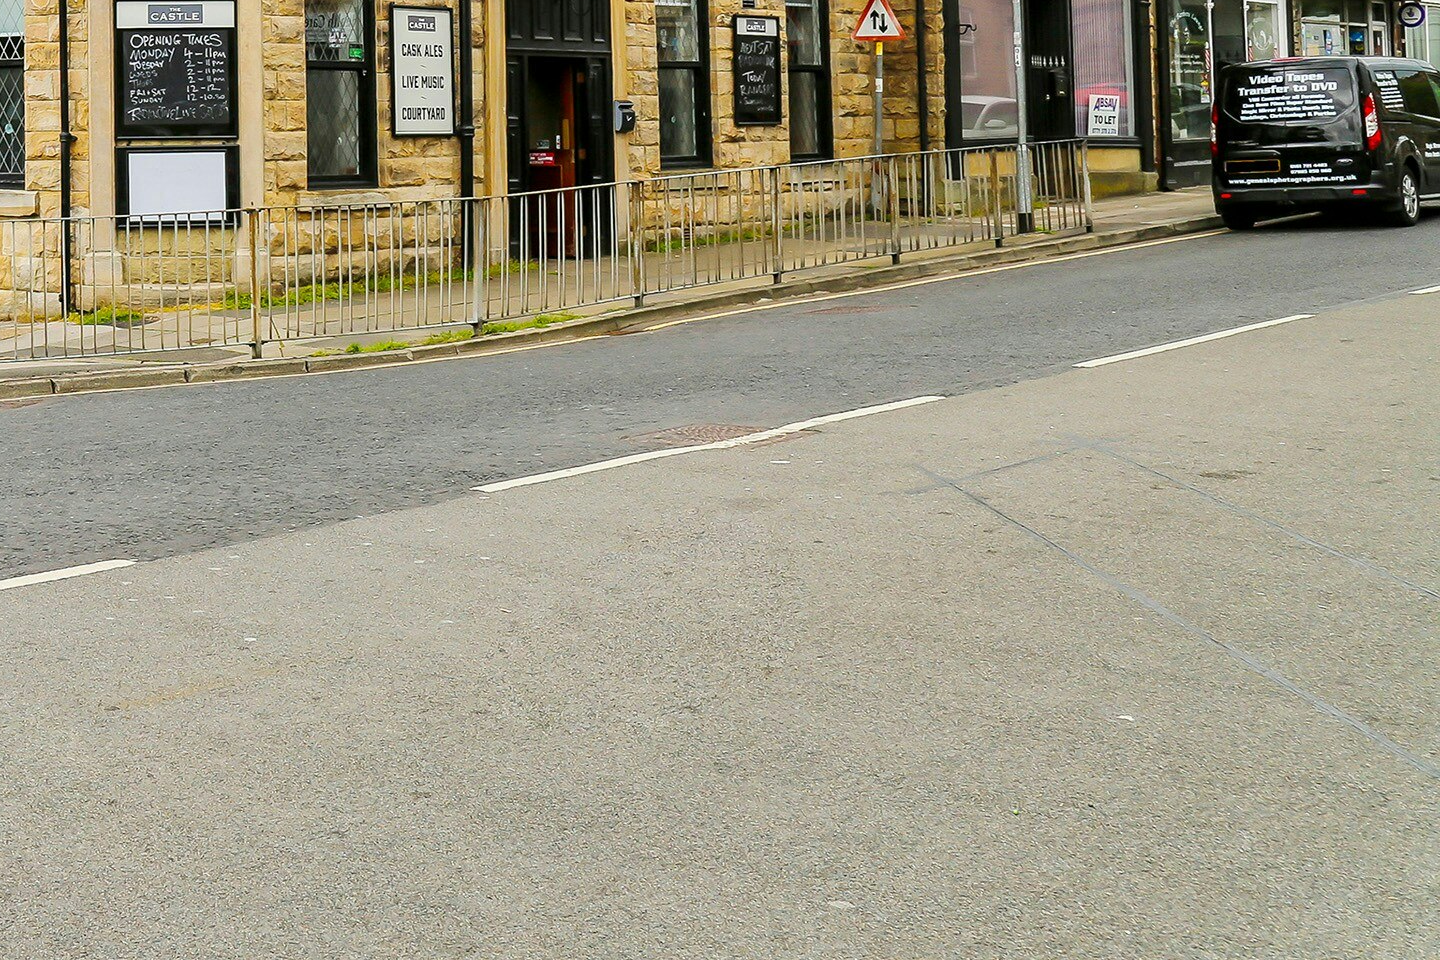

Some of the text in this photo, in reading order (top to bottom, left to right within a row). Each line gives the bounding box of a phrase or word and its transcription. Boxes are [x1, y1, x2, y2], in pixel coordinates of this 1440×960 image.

[150, 12, 200, 21] CASTLE
[408, 21, 435, 30] CASTLE
[130, 33, 223, 48] OPENING TIMES
[129, 47, 175, 62] MONDAY
[401, 43, 443, 57] CASK ALES
[129, 60, 164, 71] TUESDAY
[402, 75, 445, 89] LIVE MUSIC
[1248, 73, 1324, 85] Video Tapes
[1237, 82, 1337, 97] Transfer to DVD
[131, 97, 164, 105] SUNDAY
[402, 107, 446, 120] COURTYARD
[1094, 115, 1116, 125] TO LET
